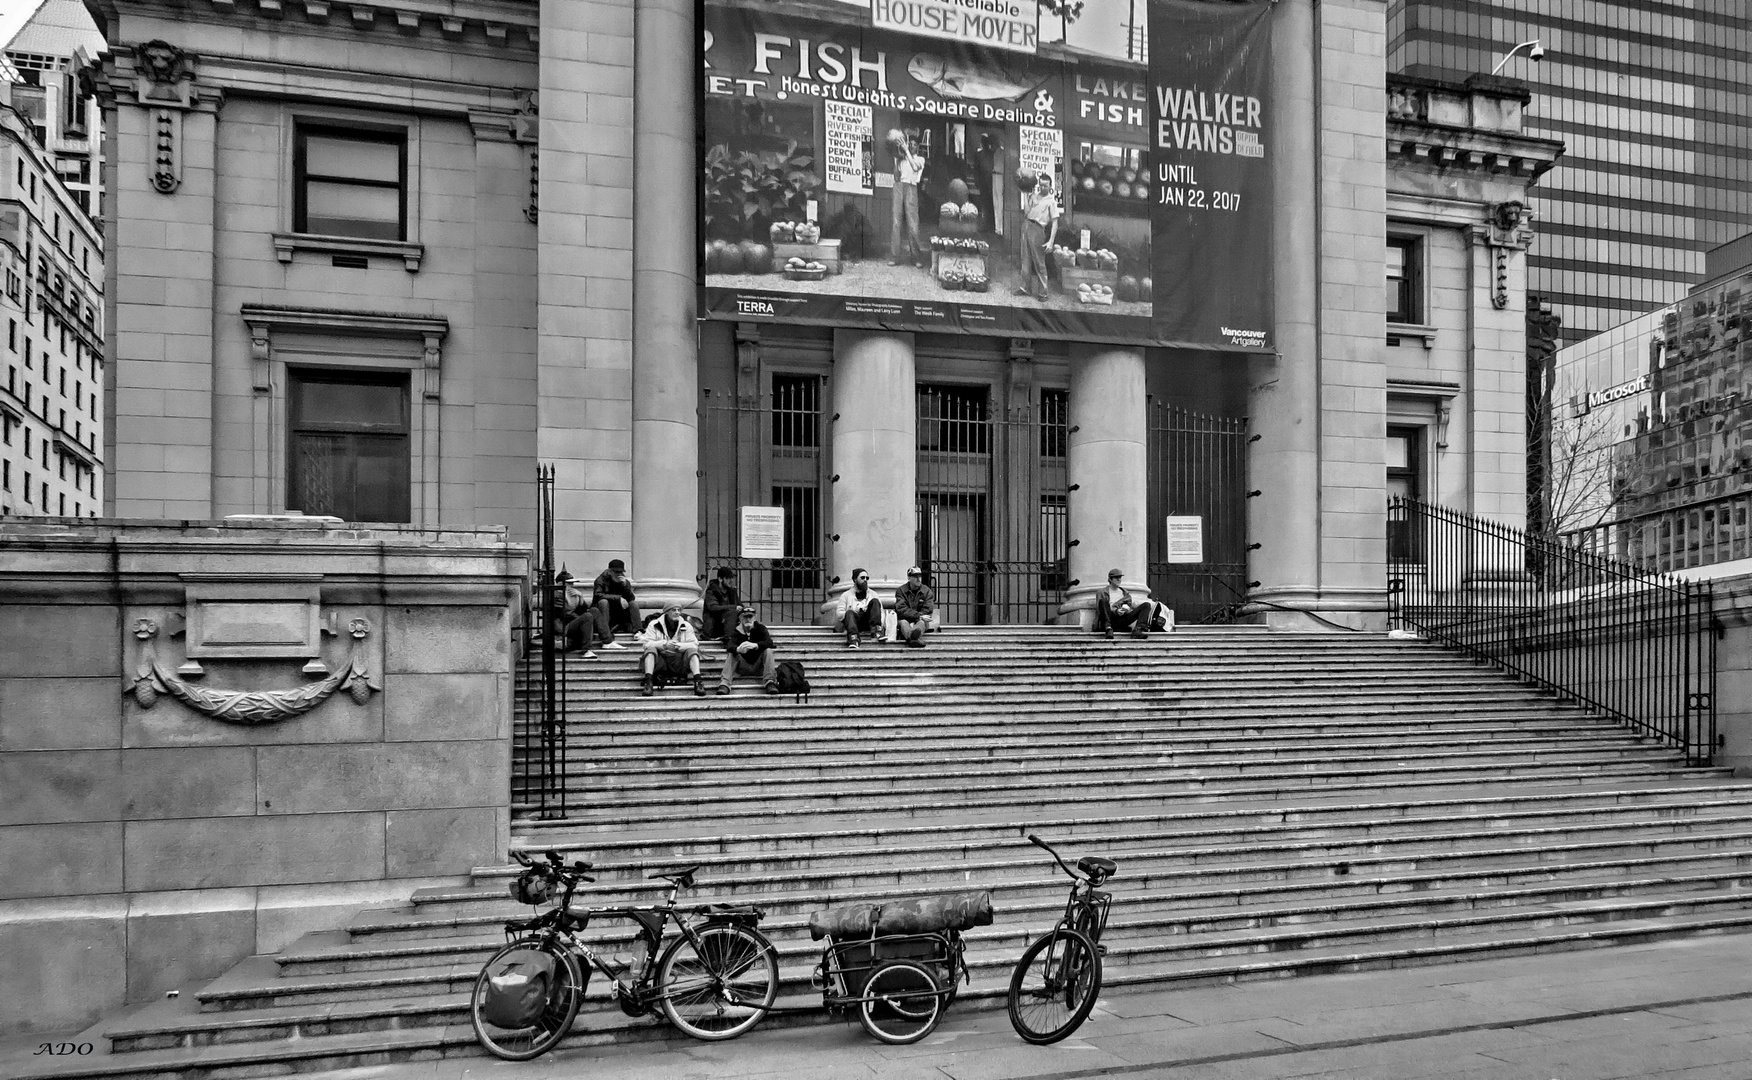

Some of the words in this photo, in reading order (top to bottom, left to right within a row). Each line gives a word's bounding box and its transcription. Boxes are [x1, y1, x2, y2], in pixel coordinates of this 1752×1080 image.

[876, 0, 957, 33] HOUSE
[963, 13, 1036, 48] MOVER
[754, 33, 888, 91] FISH
[1076, 75, 1146, 101] LAKE
[782, 76, 838, 99] Honest
[915, 96, 979, 118] Square
[984, 104, 1056, 127] Dealings
[1034, 89, 1054, 112] &
[1157, 86, 1262, 128] WALKER
[1081, 100, 1142, 126] FISH
[827, 121, 853, 132] RIVER
[855, 125, 872, 135] FISH
[1158, 119, 1233, 154] EVANS
[828, 139, 857, 149] TROUT
[828, 147, 855, 158] PERCH
[1022, 145, 1043, 154] RIVER
[1045, 148, 1061, 156] FISH
[828, 156, 852, 167] DRUM
[828, 165, 861, 176] BUFFALO
[1023, 161, 1047, 171] TROUT
[828, 173, 843, 182] EEL
[1159, 163, 1197, 185] UNTIL
[1159, 186, 1184, 206] JAN
[1188, 189, 1209, 210] 22,
[1213, 191, 1240, 212] 2017
[737, 300, 775, 314] TERRA
[1221, 326, 1266, 338] Vancouver
[1231, 336, 1266, 348] Artgallery
[1588, 376, 1646, 407] Microsoft
